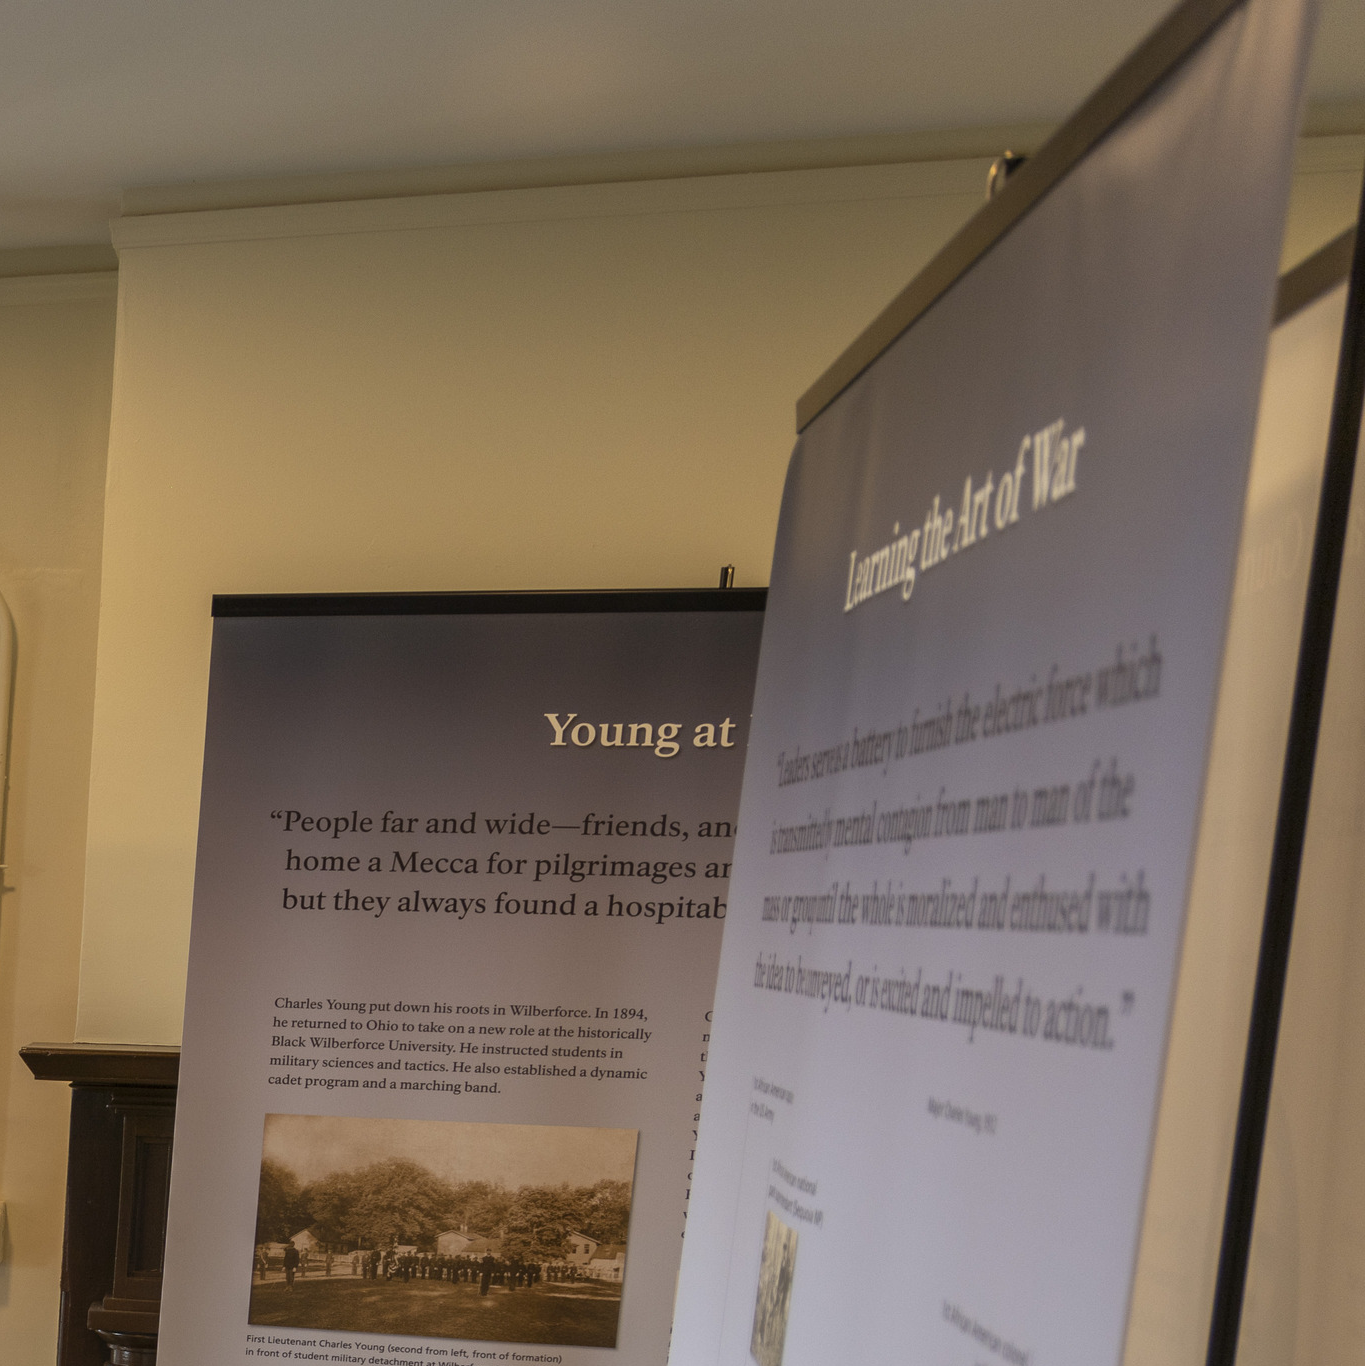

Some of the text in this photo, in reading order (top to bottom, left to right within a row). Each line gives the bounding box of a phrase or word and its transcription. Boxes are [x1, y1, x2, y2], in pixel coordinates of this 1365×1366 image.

[844, 416, 1085, 613] Learning the Art of War
[544, 713, 736, 757] Young at
[270, 810, 373, 839] “People
[380, 810, 419, 833] far
[426, 812, 476, 834] and
[285, 849, 360, 872] home
[368, 857, 382, 872] a
[390, 851, 478, 874] Mecca
[486, 852, 527, 874] for
[533, 853, 696, 884] pilgrimages
[283, 888, 326, 910] but
[334, 889, 391, 918] they
[397, 890, 486, 920] always
[494, 891, 576, 916] found
[584, 901, 598, 916] a
[273, 997, 648, 1022] Charles Young put down his roots in Wilberforce. In 1894,
[245, 1335, 562, 1364] First Lieutenant Charles Young (second from left, front of formation)
